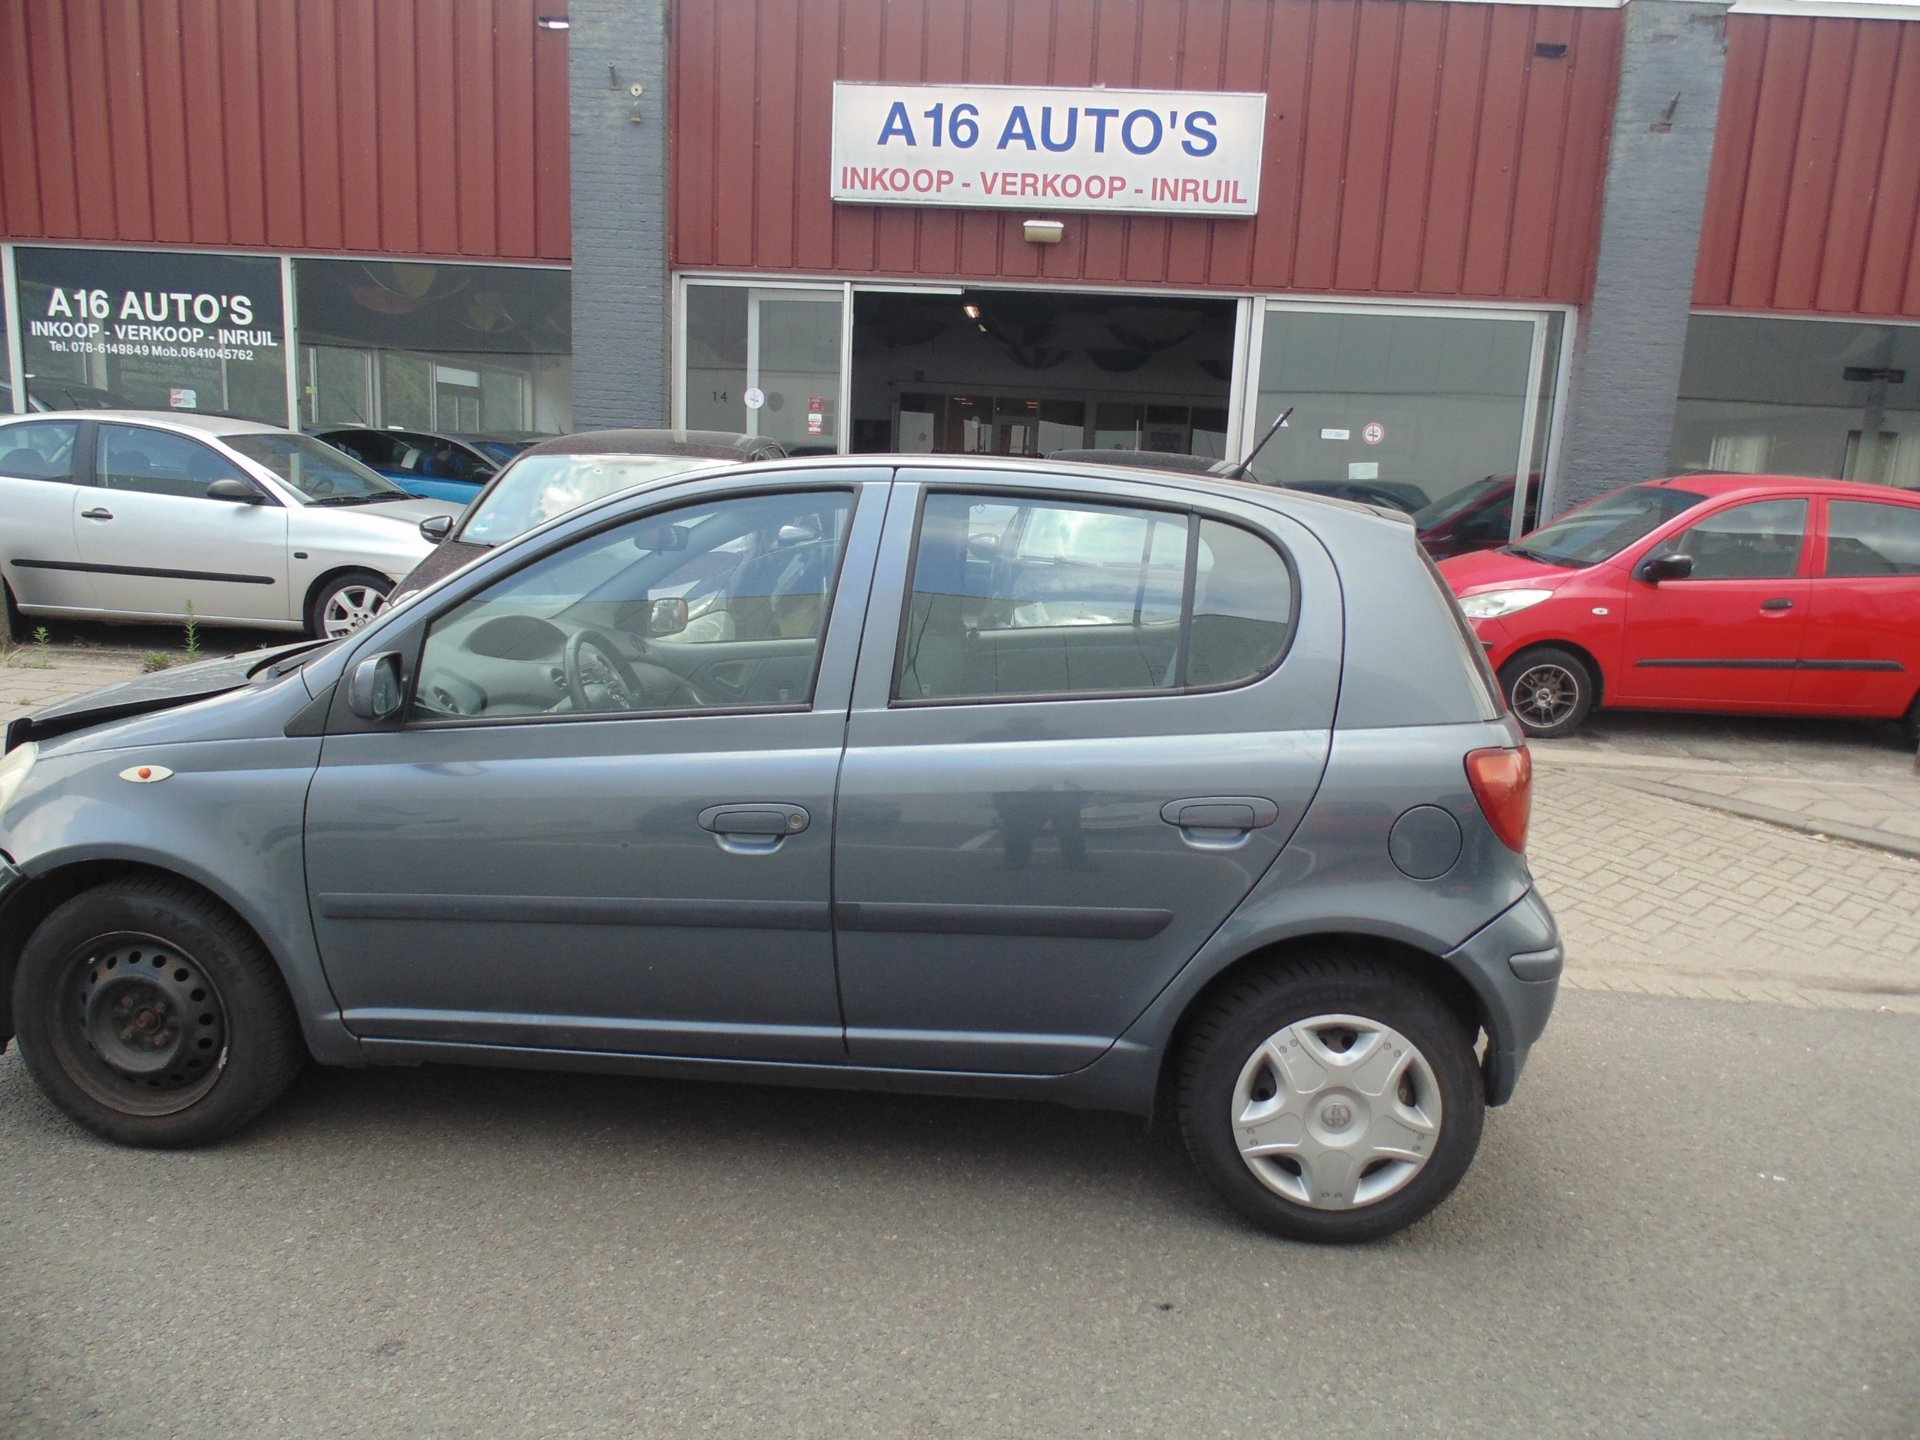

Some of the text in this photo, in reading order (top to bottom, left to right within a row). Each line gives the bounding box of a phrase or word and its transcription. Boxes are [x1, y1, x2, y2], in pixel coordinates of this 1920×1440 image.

[877, 101, 1218, 157] A16 AUTO'S
[841, 166, 954, 193] INKOOP
[980, 171, 1127, 199] VERKOOP
[1150, 177, 1248, 204] INRUIL
[47, 287, 253, 326] A16 AUTO'S
[31, 320, 100, 338] INKOOP
[114, 324, 204, 343] VERKOOP
[218, 328, 278, 347] INRUIL
[49, 340, 70, 352] Tel.
[71, 341, 149, 356] 078-6149849
[713, 391, 728, 403] 14
